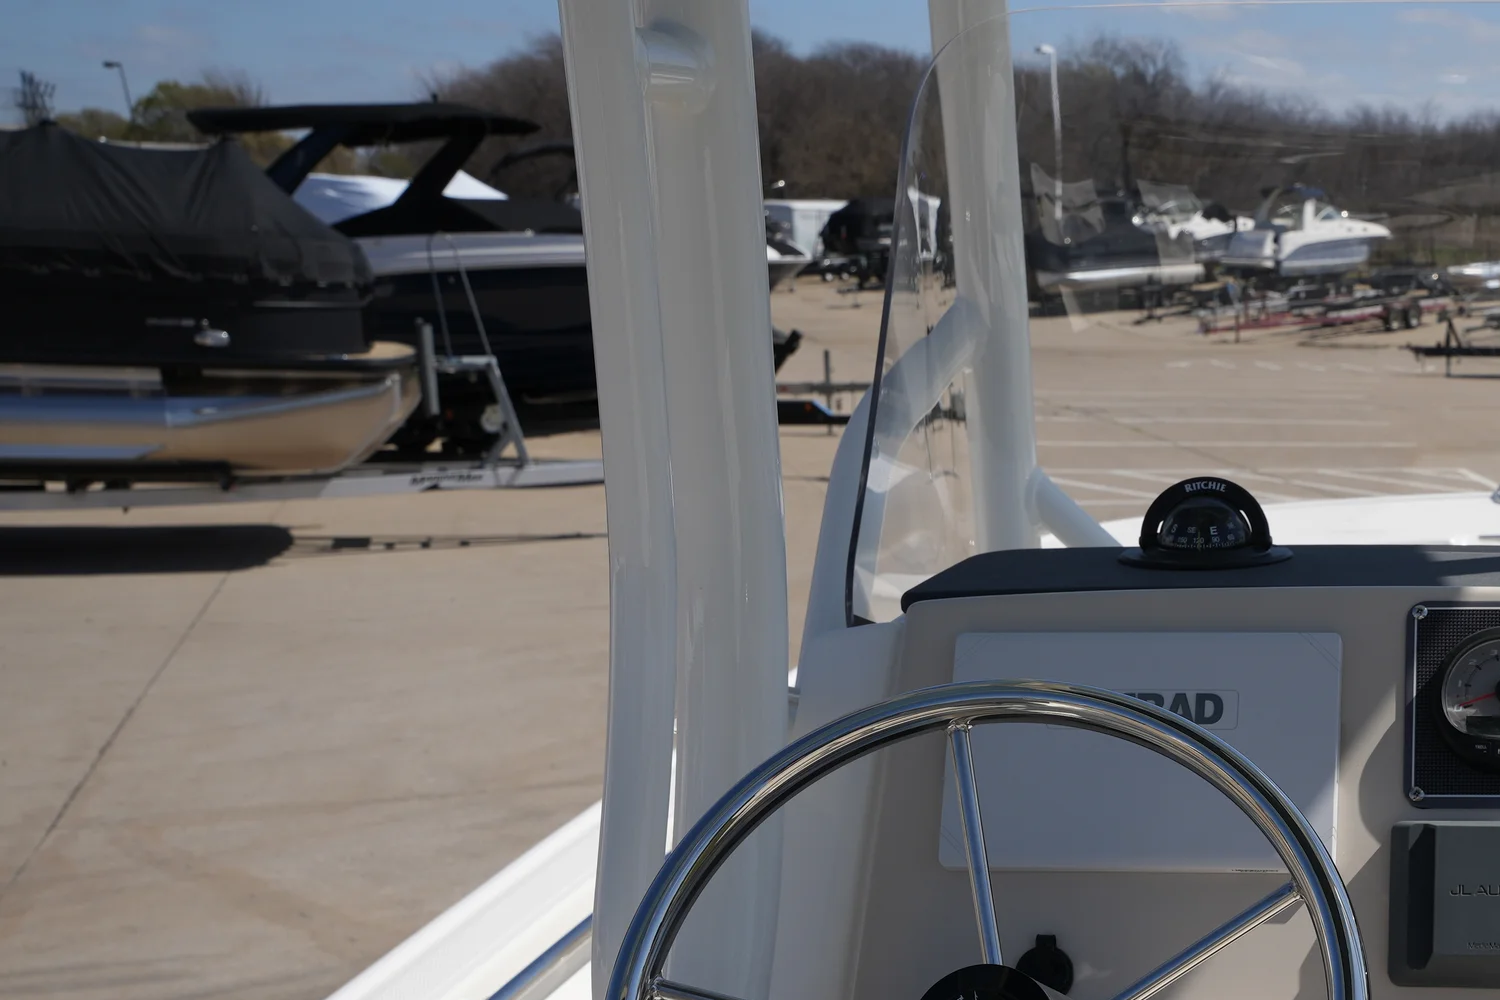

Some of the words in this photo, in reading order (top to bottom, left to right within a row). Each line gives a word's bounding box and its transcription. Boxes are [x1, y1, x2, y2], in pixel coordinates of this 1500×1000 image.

[1184, 481, 1227, 492] RITCHIE
[1209, 526, 1218, 535] E
[1450, 884, 1471, 897] JL
